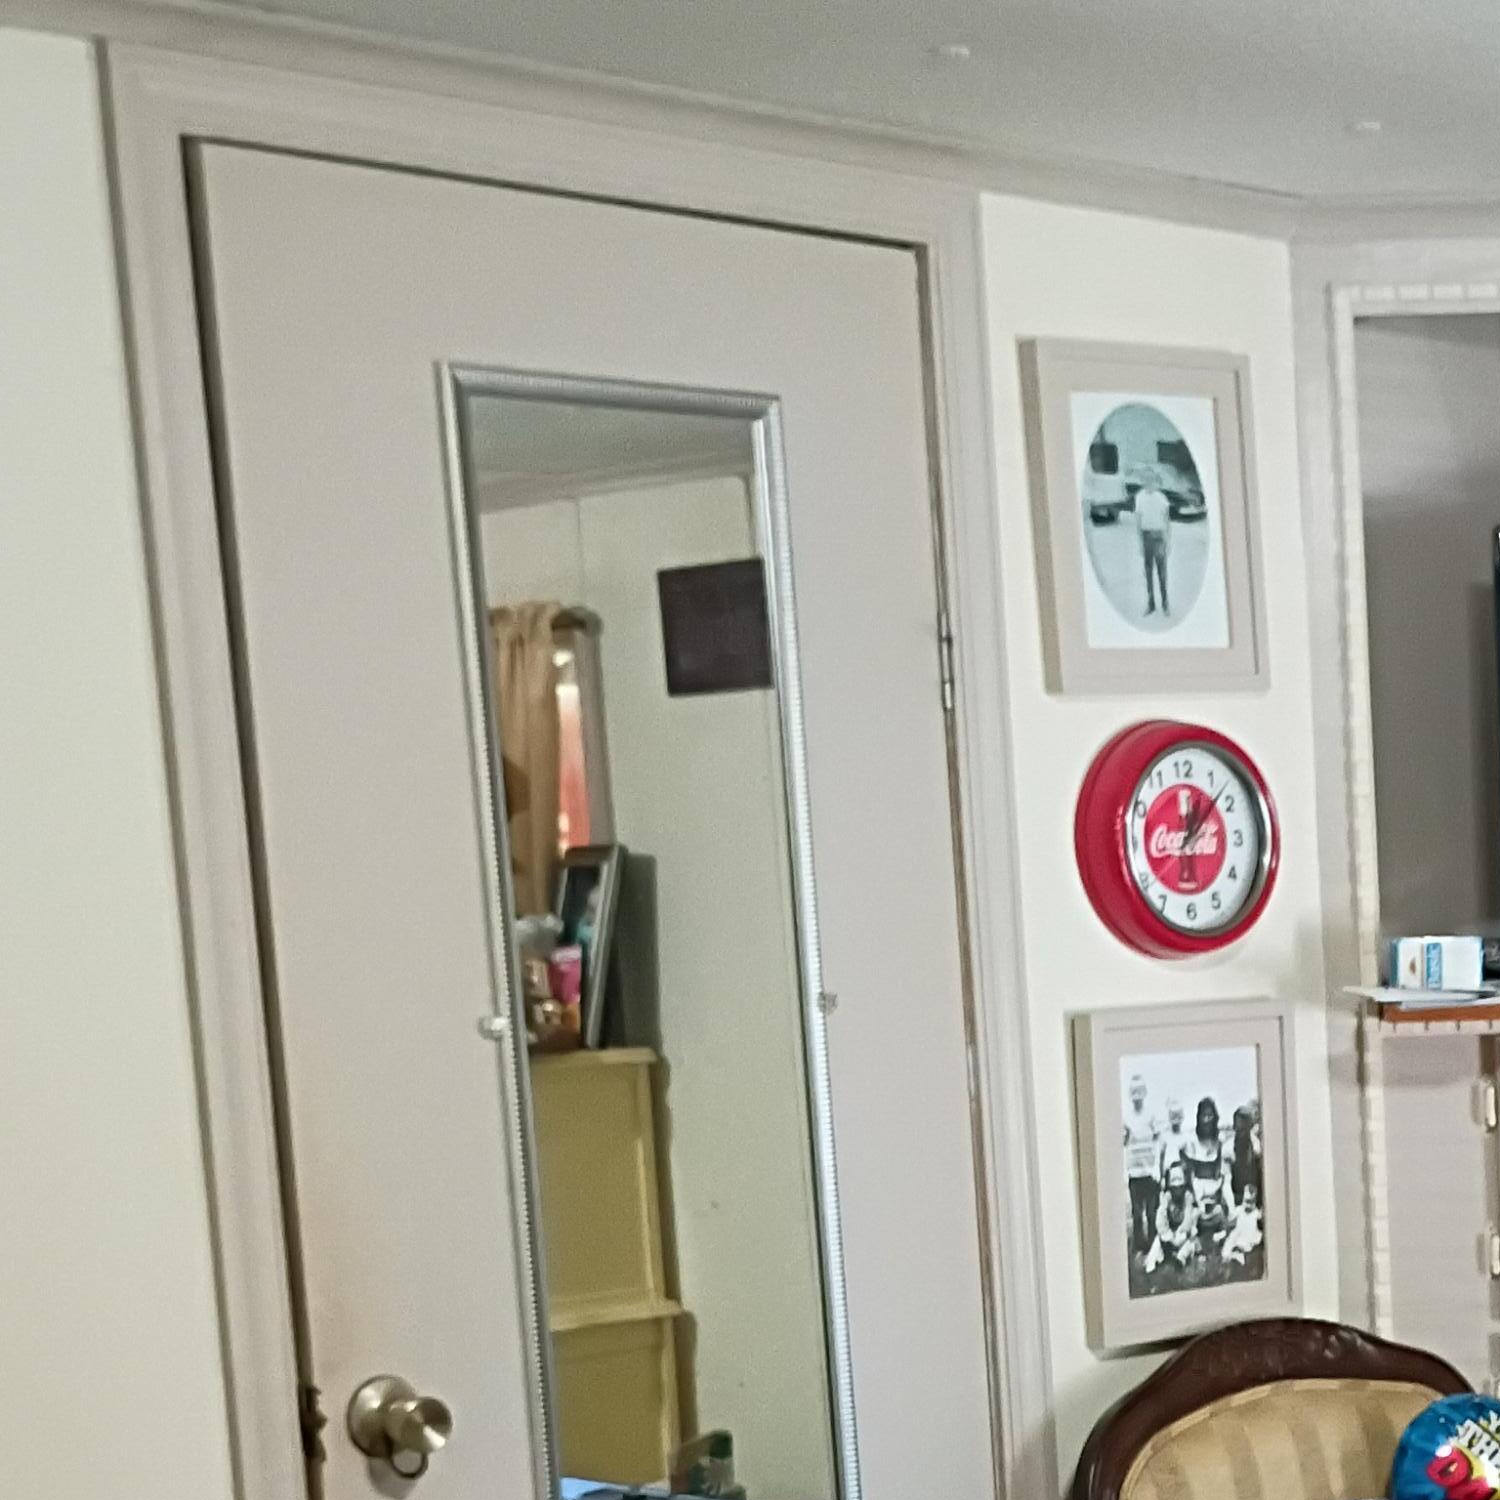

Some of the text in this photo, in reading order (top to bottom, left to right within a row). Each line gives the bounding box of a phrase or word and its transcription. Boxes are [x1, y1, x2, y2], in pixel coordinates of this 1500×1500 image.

[1173, 760, 1193, 779] 12
[1225, 795, 1235, 813] 2
[1150, 821, 1218, 858] CocaCola
[1233, 829, 1243, 847] 3
[1227, 865, 1237, 881] 4
[1158, 894, 1168, 915] 7
[1211, 891, 1221, 910] 5
[1187, 902, 1197, 920] 6
